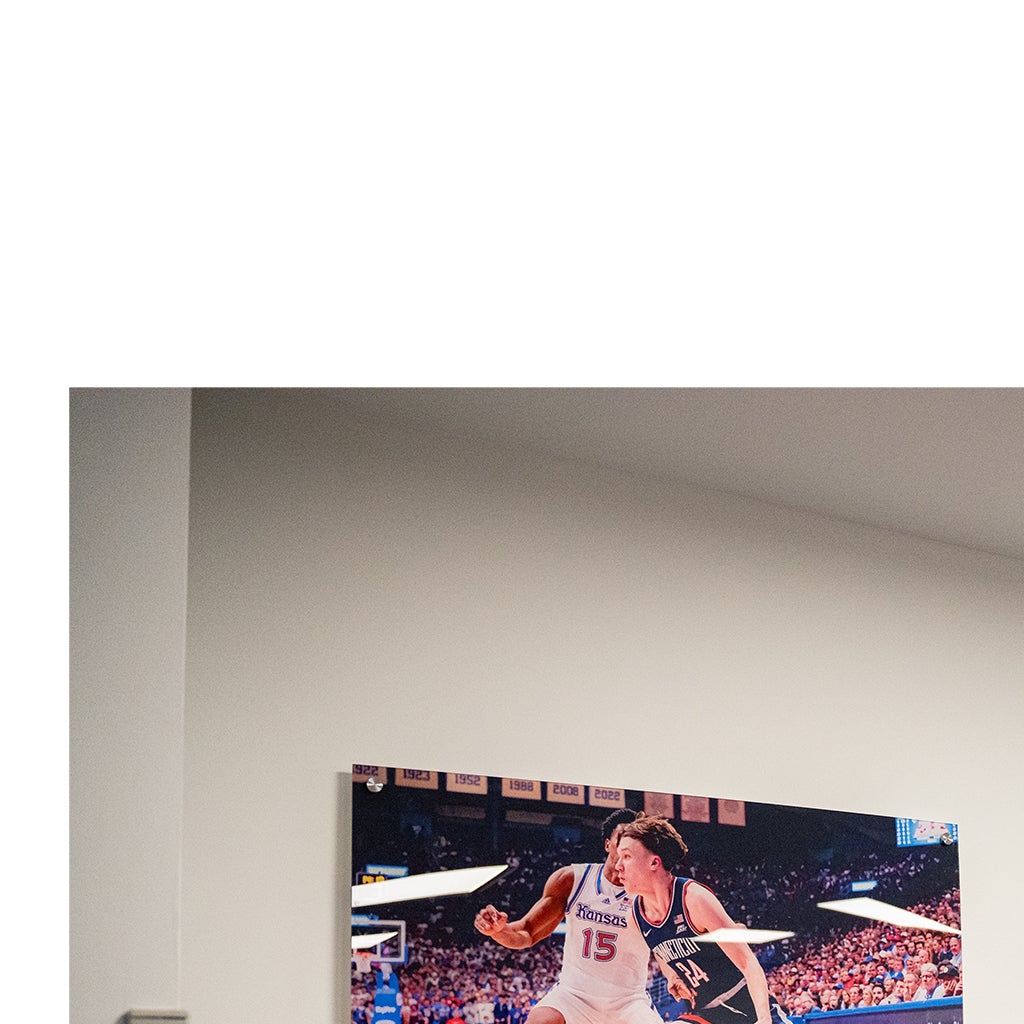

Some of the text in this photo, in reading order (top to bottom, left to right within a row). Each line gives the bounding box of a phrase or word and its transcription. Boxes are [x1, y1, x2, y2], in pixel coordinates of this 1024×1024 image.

[403, 768, 430, 781] 1923
[455, 773, 480, 786] 1952
[509, 780, 534, 792] 1988
[553, 784, 579, 797] 2008
[594, 789, 620, 801] 2022
[575, 903, 628, 929] Kansas
[582, 927, 618, 962] 15
[675, 959, 710, 988] 24
